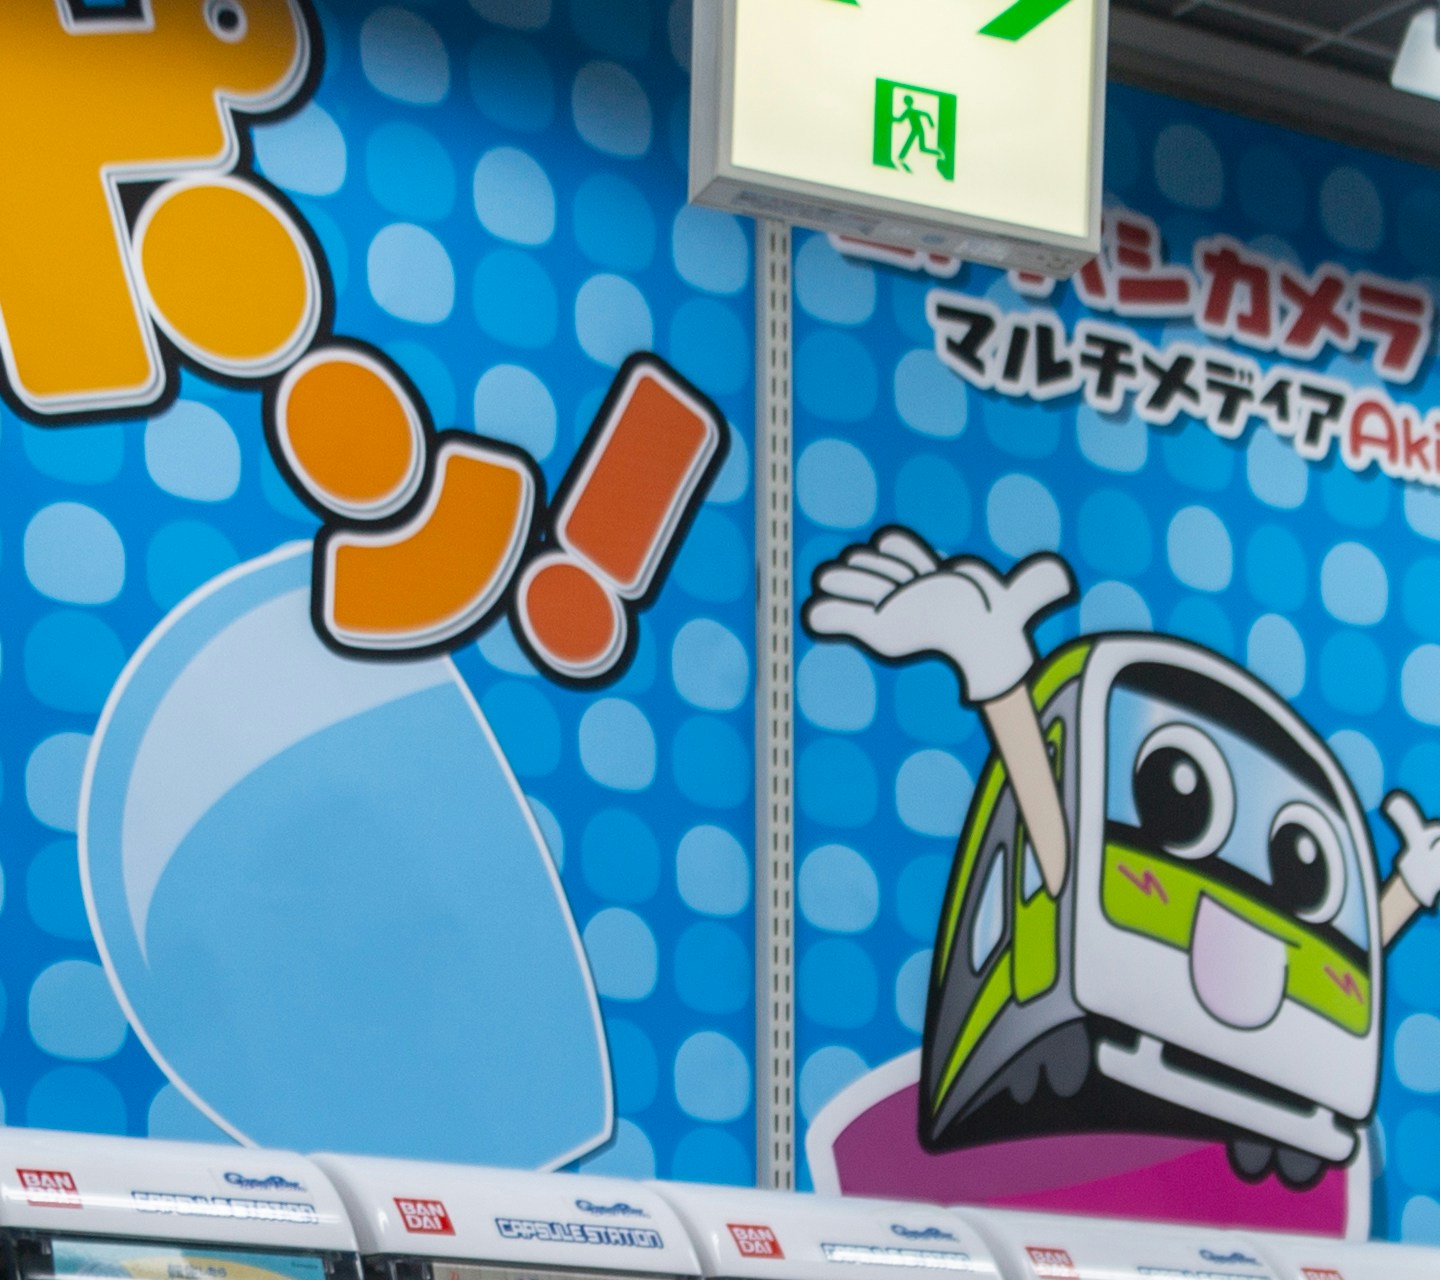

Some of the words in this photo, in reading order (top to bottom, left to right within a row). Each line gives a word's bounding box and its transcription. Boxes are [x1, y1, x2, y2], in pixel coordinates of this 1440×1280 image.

[934, 300, 1348, 451] マルチメディア
[22, 1171, 72, 1190] BAN
[399, 1200, 446, 1217] BAN
[405, 1215, 441, 1232] DAI
[496, 1218, 580, 1243] CAPSULE
[580, 1224, 663, 1249] STATION
[733, 1226, 771, 1243] BAN
